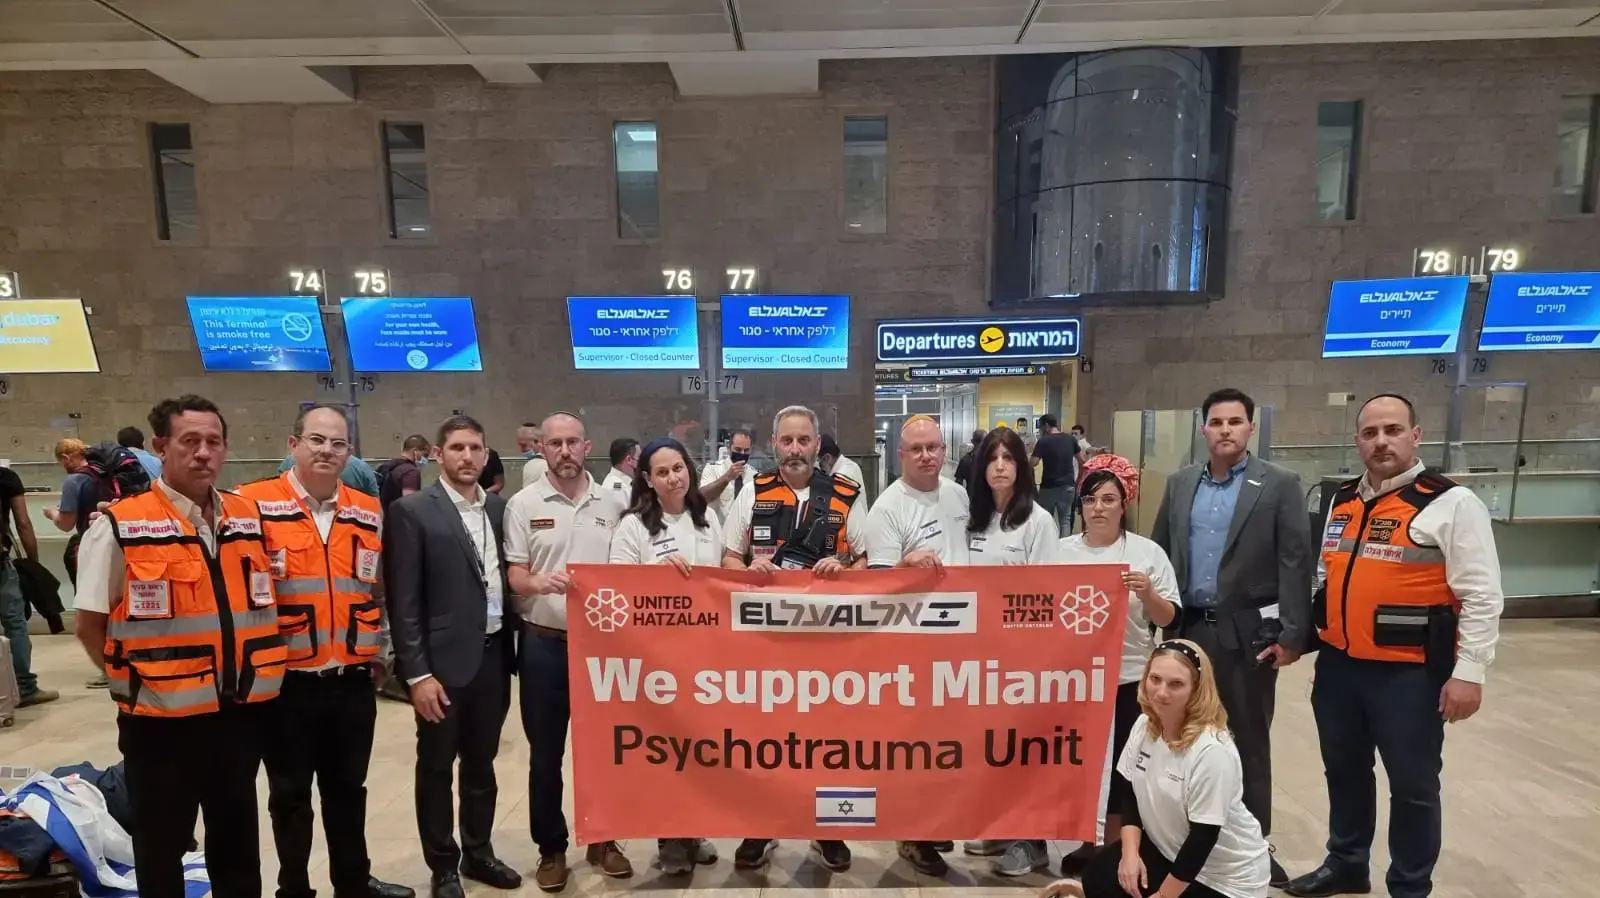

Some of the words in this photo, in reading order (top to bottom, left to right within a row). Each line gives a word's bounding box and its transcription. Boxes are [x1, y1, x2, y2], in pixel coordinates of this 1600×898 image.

[1420, 251, 1450, 273] 78
[1488, 249, 1518, 271] 79
[289, 271, 322, 292] 74
[354, 272, 386, 293] 75
[662, 269, 693, 290] 76
[726, 269, 755, 290] 77
[1380, 309, 1412, 320] תיירים
[1536, 303, 1566, 314] תיירים
[203, 319, 223, 329] This
[226, 319, 268, 329] Terminal
[620, 326, 650, 337] אחראי
[738, 325, 762, 336] סגור
[772, 325, 805, 336] אחראי
[807, 324, 836, 339] דלפק
[206, 330, 215, 339] is
[216, 329, 248, 339] smoke
[250, 330, 271, 339] free
[588, 327, 611, 337] סגור
[652, 325, 680, 339] דלפק
[1007, 330, 1074, 348] המראות
[1525, 333, 1564, 344] Economy
[883, 331, 976, 354] Departures
[1370, 338, 1411, 350] Economy
[578, 352, 623, 362] Supervisor
[630, 352, 658, 361] Closed
[660, 352, 695, 361] Counter
[725, 354, 773, 363] Supervisor
[781, 353, 811, 363] Closed
[1431, 359, 1446, 374] 78
[1472, 358, 1487, 372] 79
[322, 377, 336, 392] 74
[360, 377, 375, 392] 75
[687, 376, 701, 391] 76
[724, 375, 739, 390] 77
[633, 595, 693, 610] UNITED
[1002, 593, 1054, 607] איחוד
[633, 612, 719, 626] HATZALAH
[1003, 607, 1054, 622] הצלה
[586, 656, 678, 703] We
[693, 662, 916, 713] support
[931, 656, 1105, 707] Miami
[613, 724, 964, 772] Psychotrauma
[985, 726, 1083, 767] Unit
